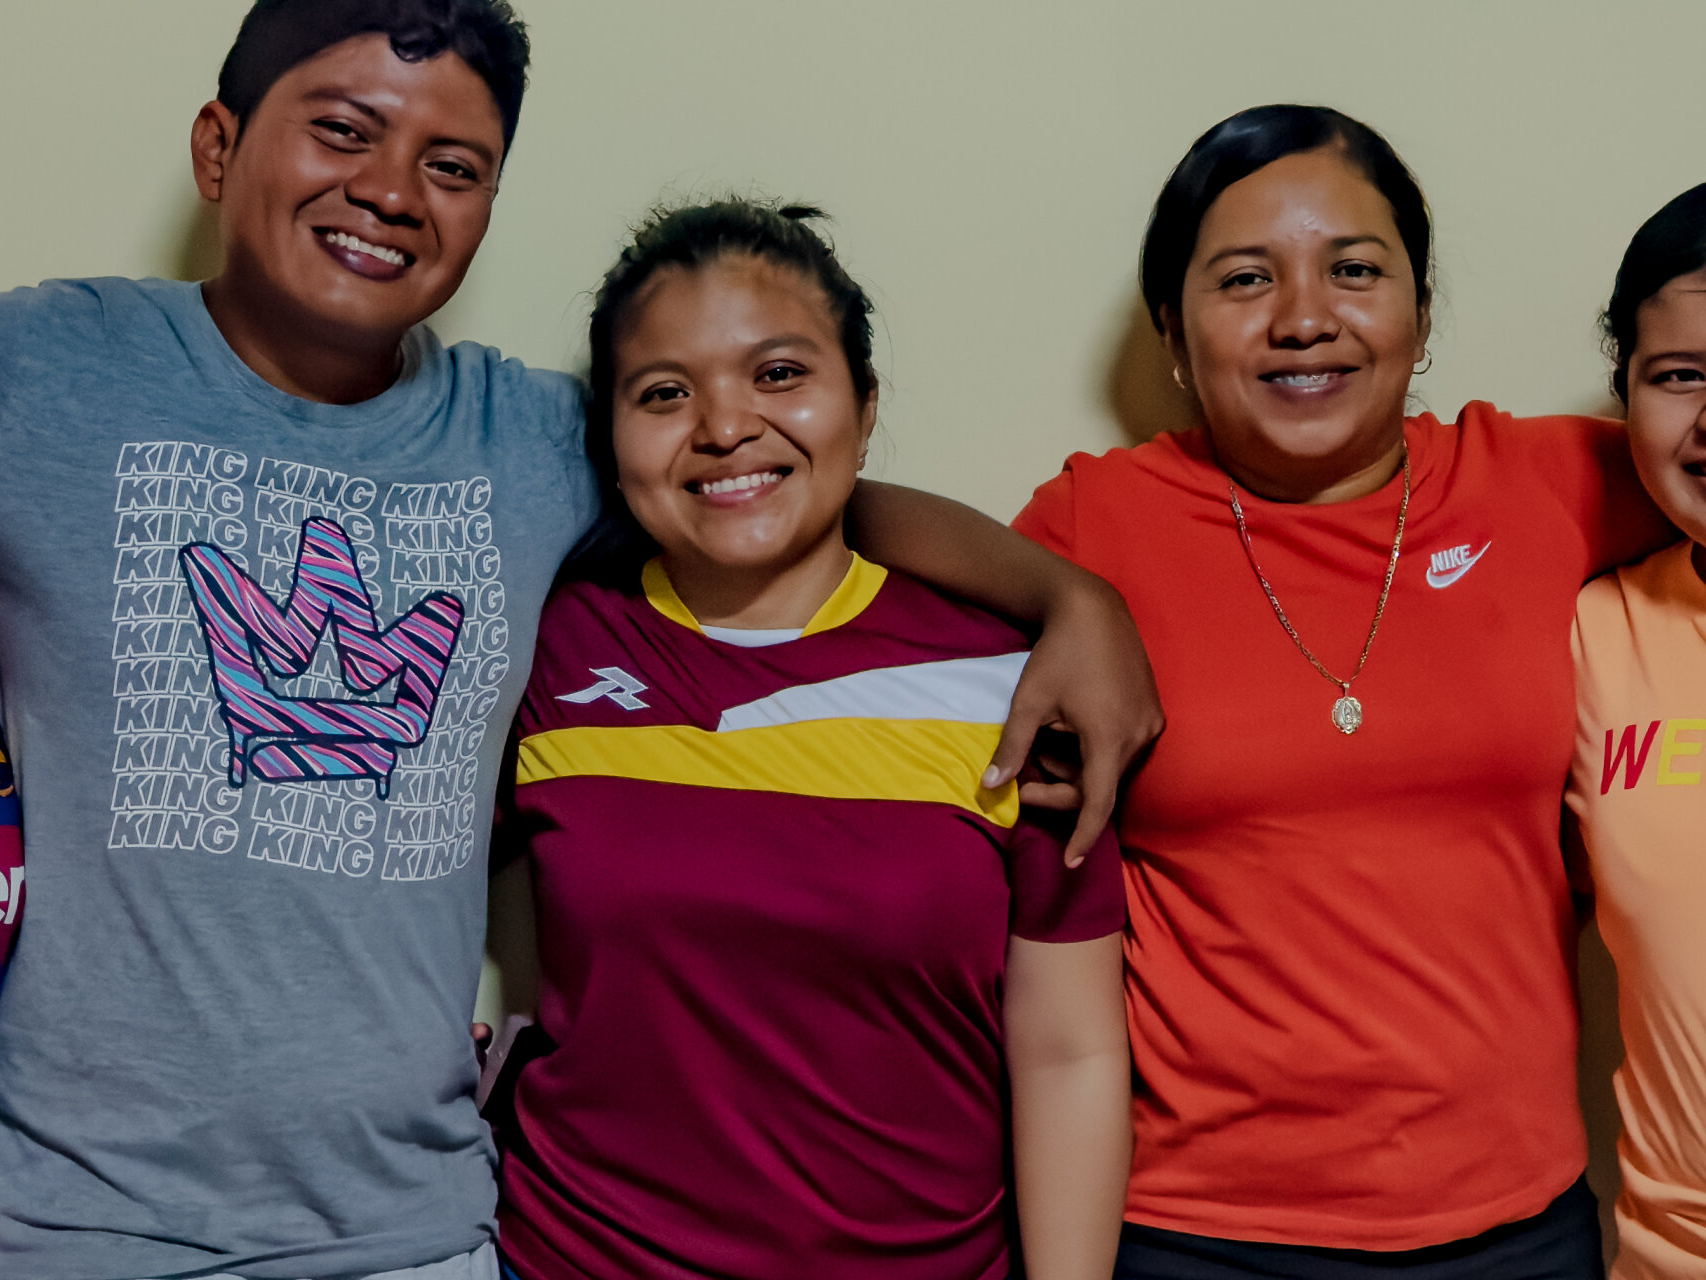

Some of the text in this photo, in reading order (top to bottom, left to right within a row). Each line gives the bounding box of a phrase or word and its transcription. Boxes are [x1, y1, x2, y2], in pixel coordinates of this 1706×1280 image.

[114, 475, 244, 517] KING
[385, 511, 493, 552] KING
[115, 440, 492, 520] KING KING KING
[114, 510, 248, 551] KING
[390, 545, 501, 585] KING
[1430, 543, 1472, 573] NIKE
[112, 618, 209, 660] KIN
[113, 656, 215, 697] KIN
[111, 771, 243, 816] KING
[251, 782, 377, 839] KING
[384, 792, 476, 844] KING
[385, 756, 479, 807] KING
[107, 810, 475, 882] KING KING KING
